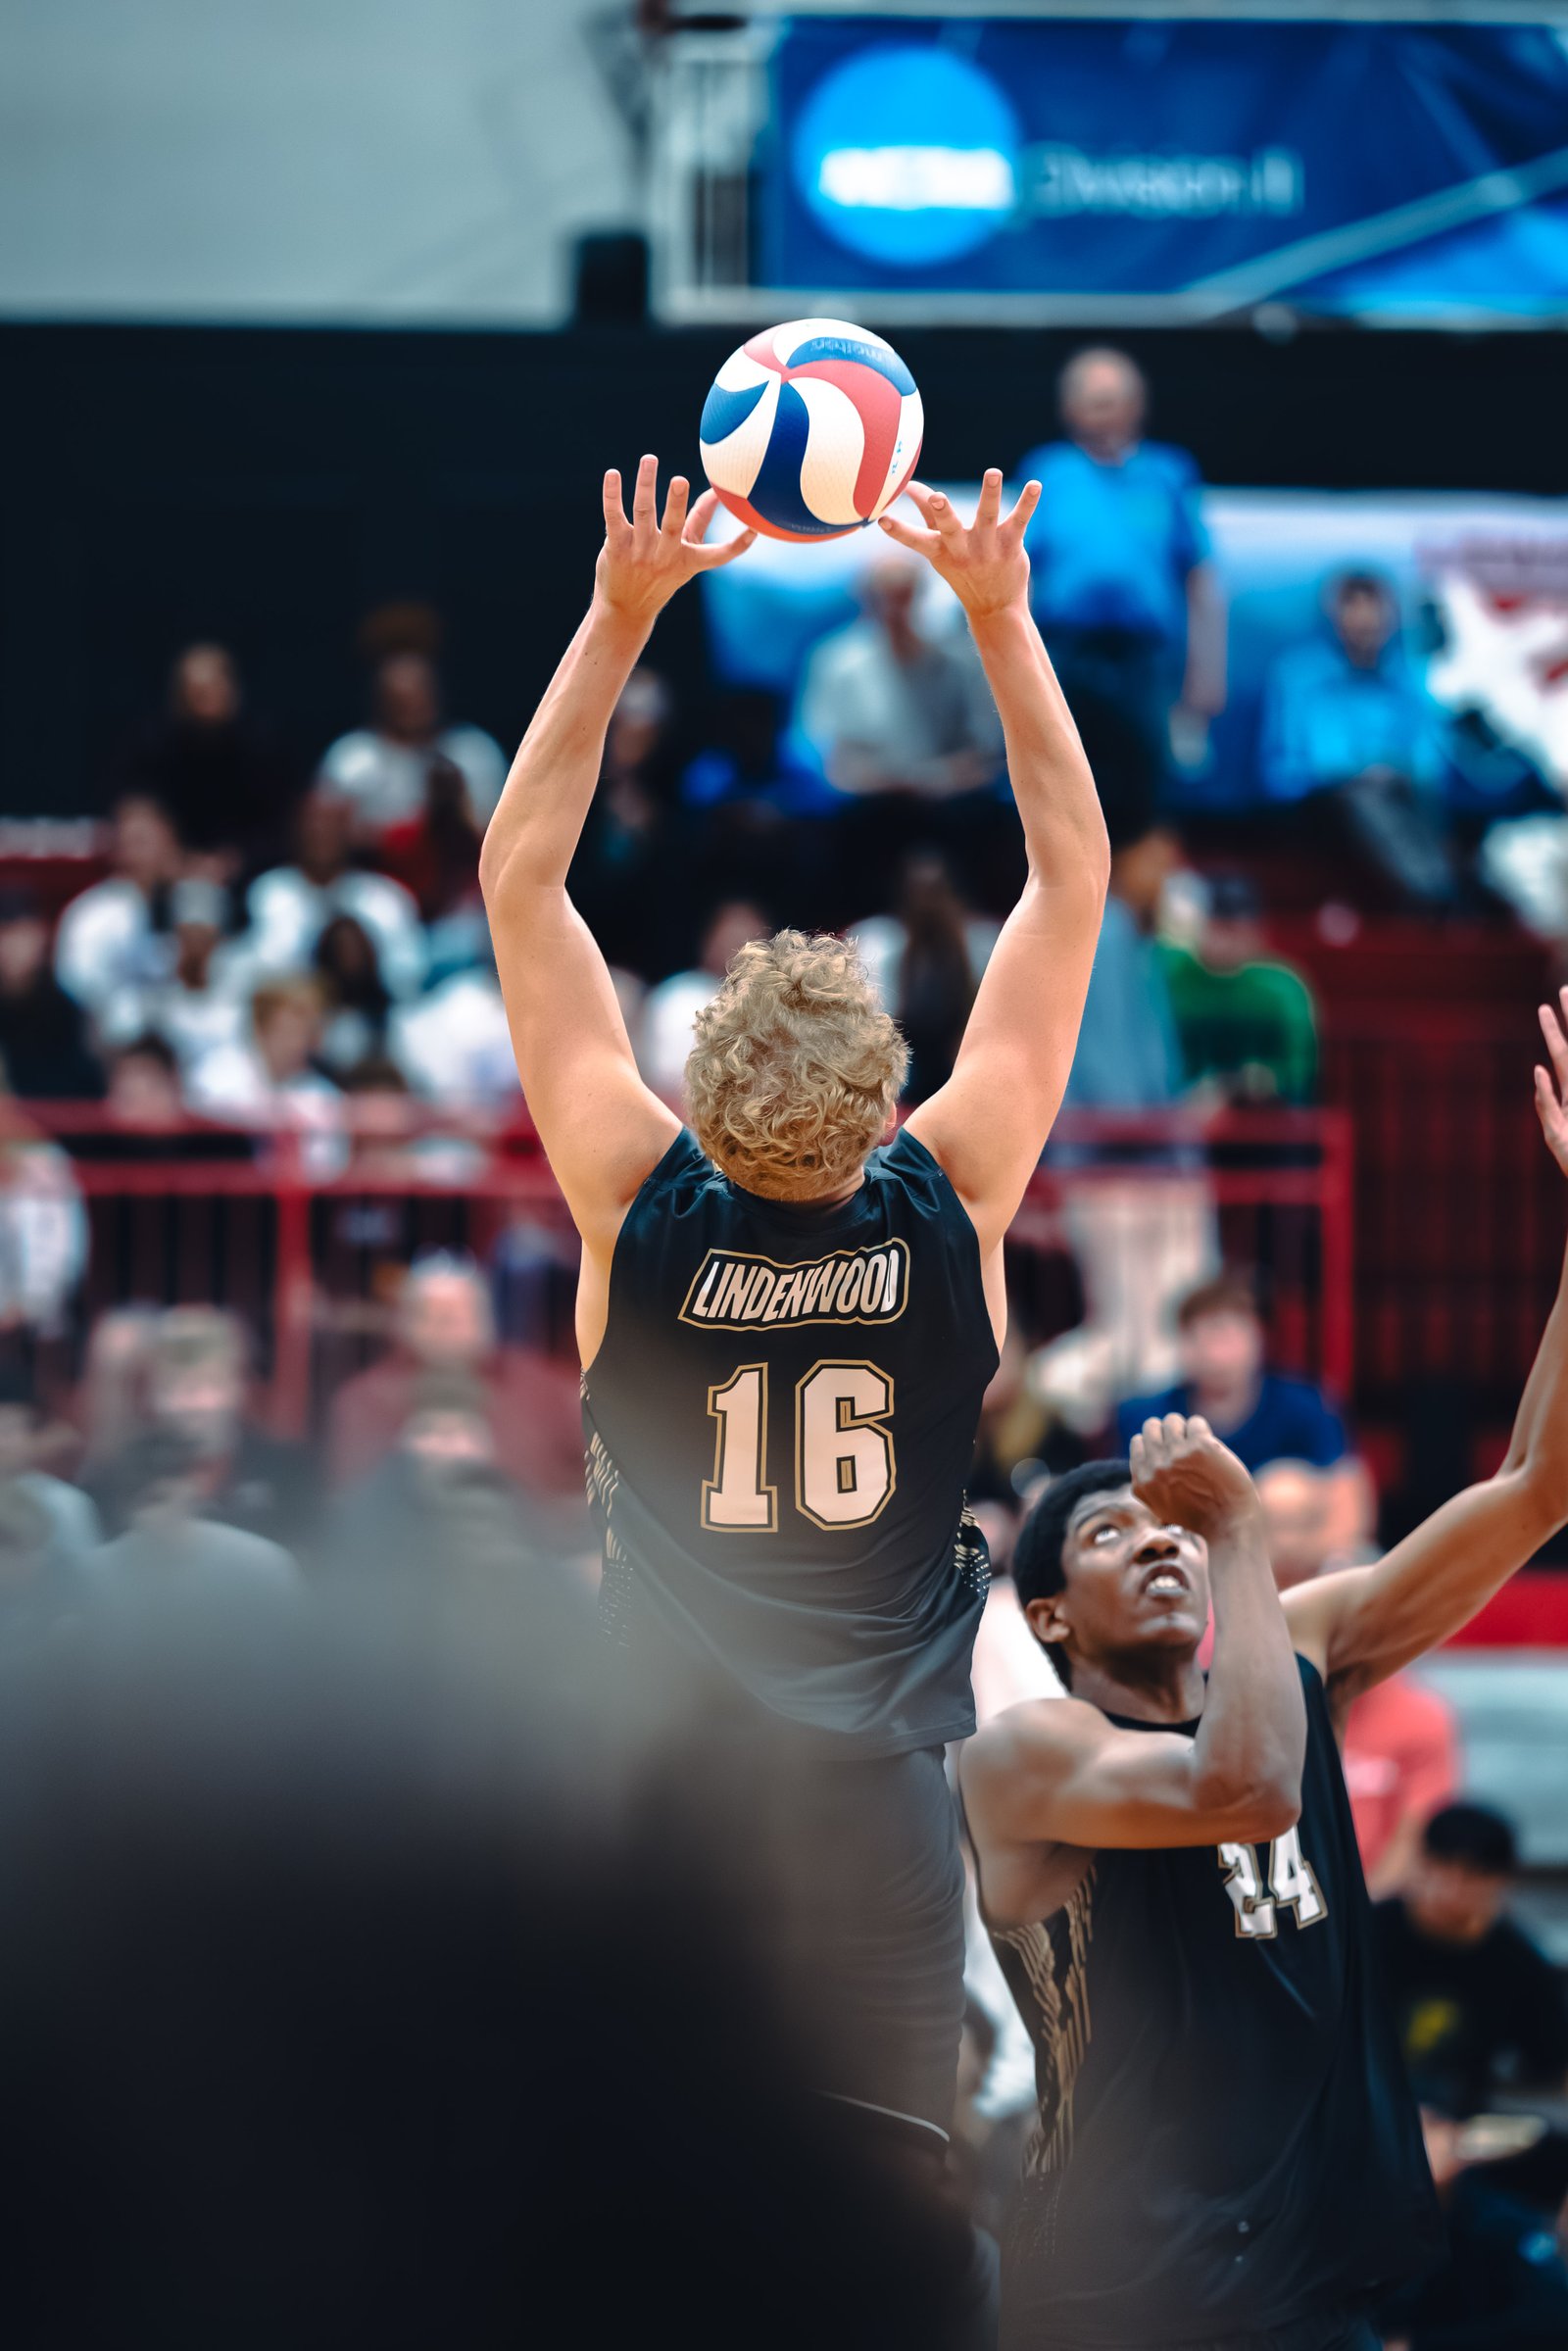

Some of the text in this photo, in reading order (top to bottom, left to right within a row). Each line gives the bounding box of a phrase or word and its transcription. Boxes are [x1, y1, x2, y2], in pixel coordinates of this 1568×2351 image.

[689, 1247, 901, 1323] LINDENWOOD
[701, 1359, 897, 1533] 16
[1217, 1824, 1329, 1940] 24
